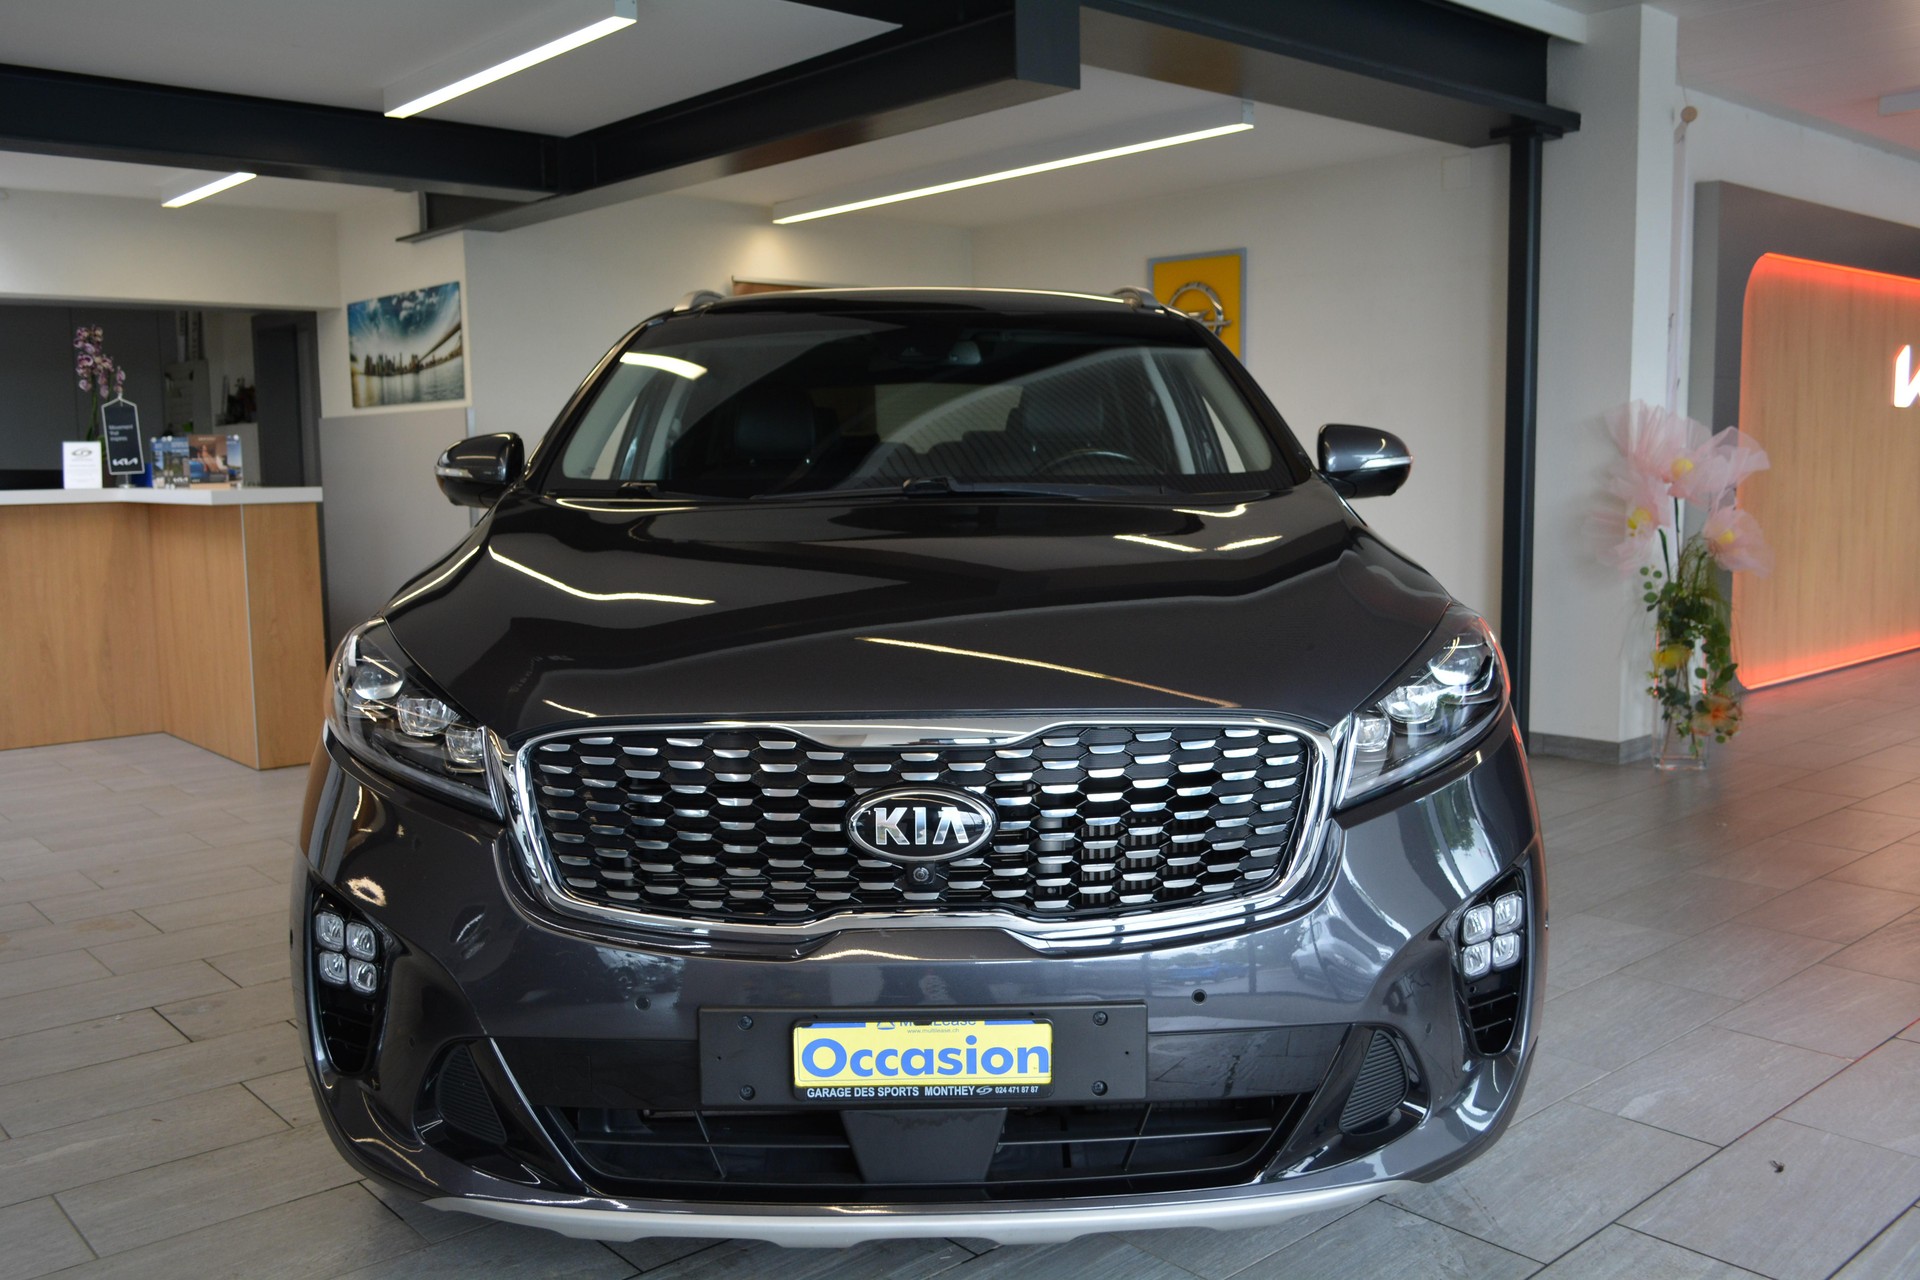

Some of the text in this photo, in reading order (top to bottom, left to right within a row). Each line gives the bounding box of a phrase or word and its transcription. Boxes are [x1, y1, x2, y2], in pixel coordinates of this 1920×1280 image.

[873, 806, 970, 845] KIA
[801, 1035, 1050, 1077] Occasion
[807, 1087, 852, 1098] GARAGE
[854, 1087, 875, 1097] DES
[877, 1086, 920, 1097] SPORTS
[924, 1086, 975, 1096] MONTHEY
[995, 1086, 1007, 1094] 024
[1008, 1086, 1020, 1094] 471
